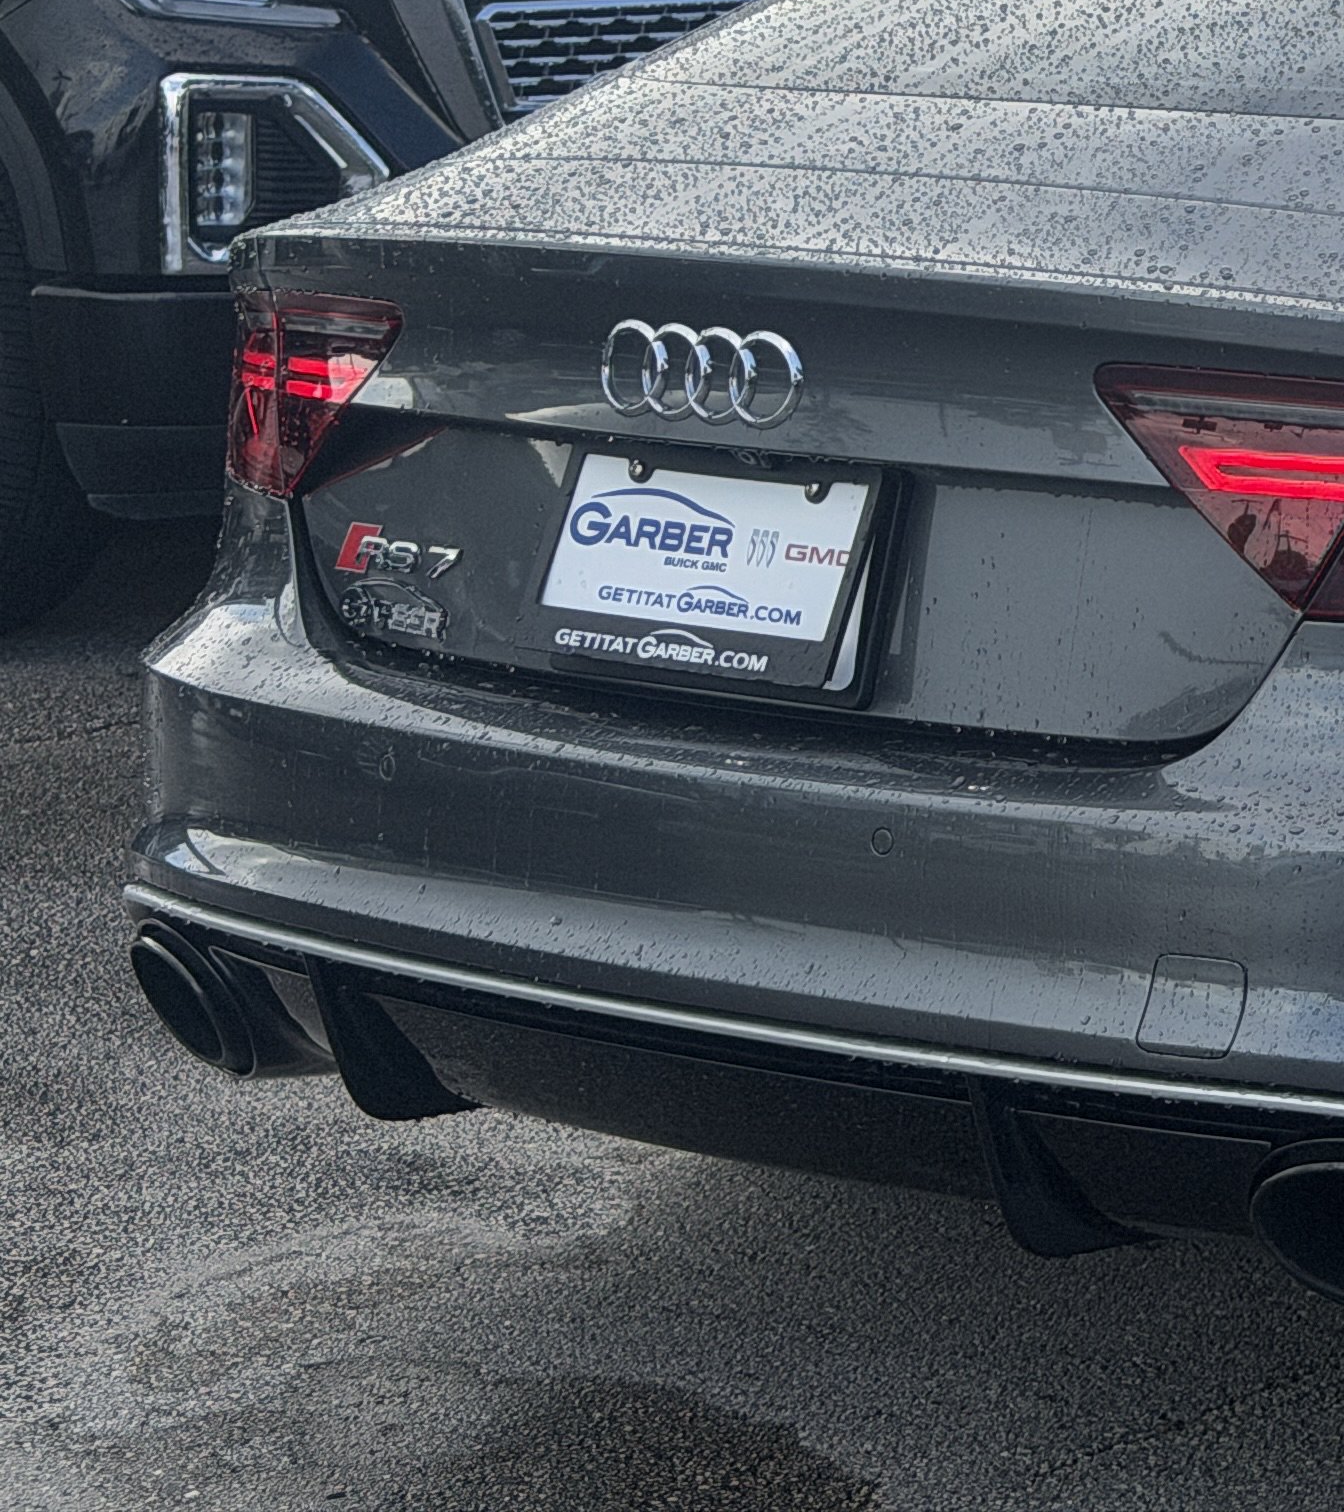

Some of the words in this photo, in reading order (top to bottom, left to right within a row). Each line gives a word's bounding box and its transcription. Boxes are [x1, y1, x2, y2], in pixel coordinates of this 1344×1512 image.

[569, 501, 736, 559] GARBER
[663, 556, 700, 570] BUICK
[701, 561, 728, 573] GMC
[784, 543, 851, 568] GMC
[597, 585, 802, 626] GETITATGARBER.COM
[554, 628, 769, 673] GETITATGARBER.COM
